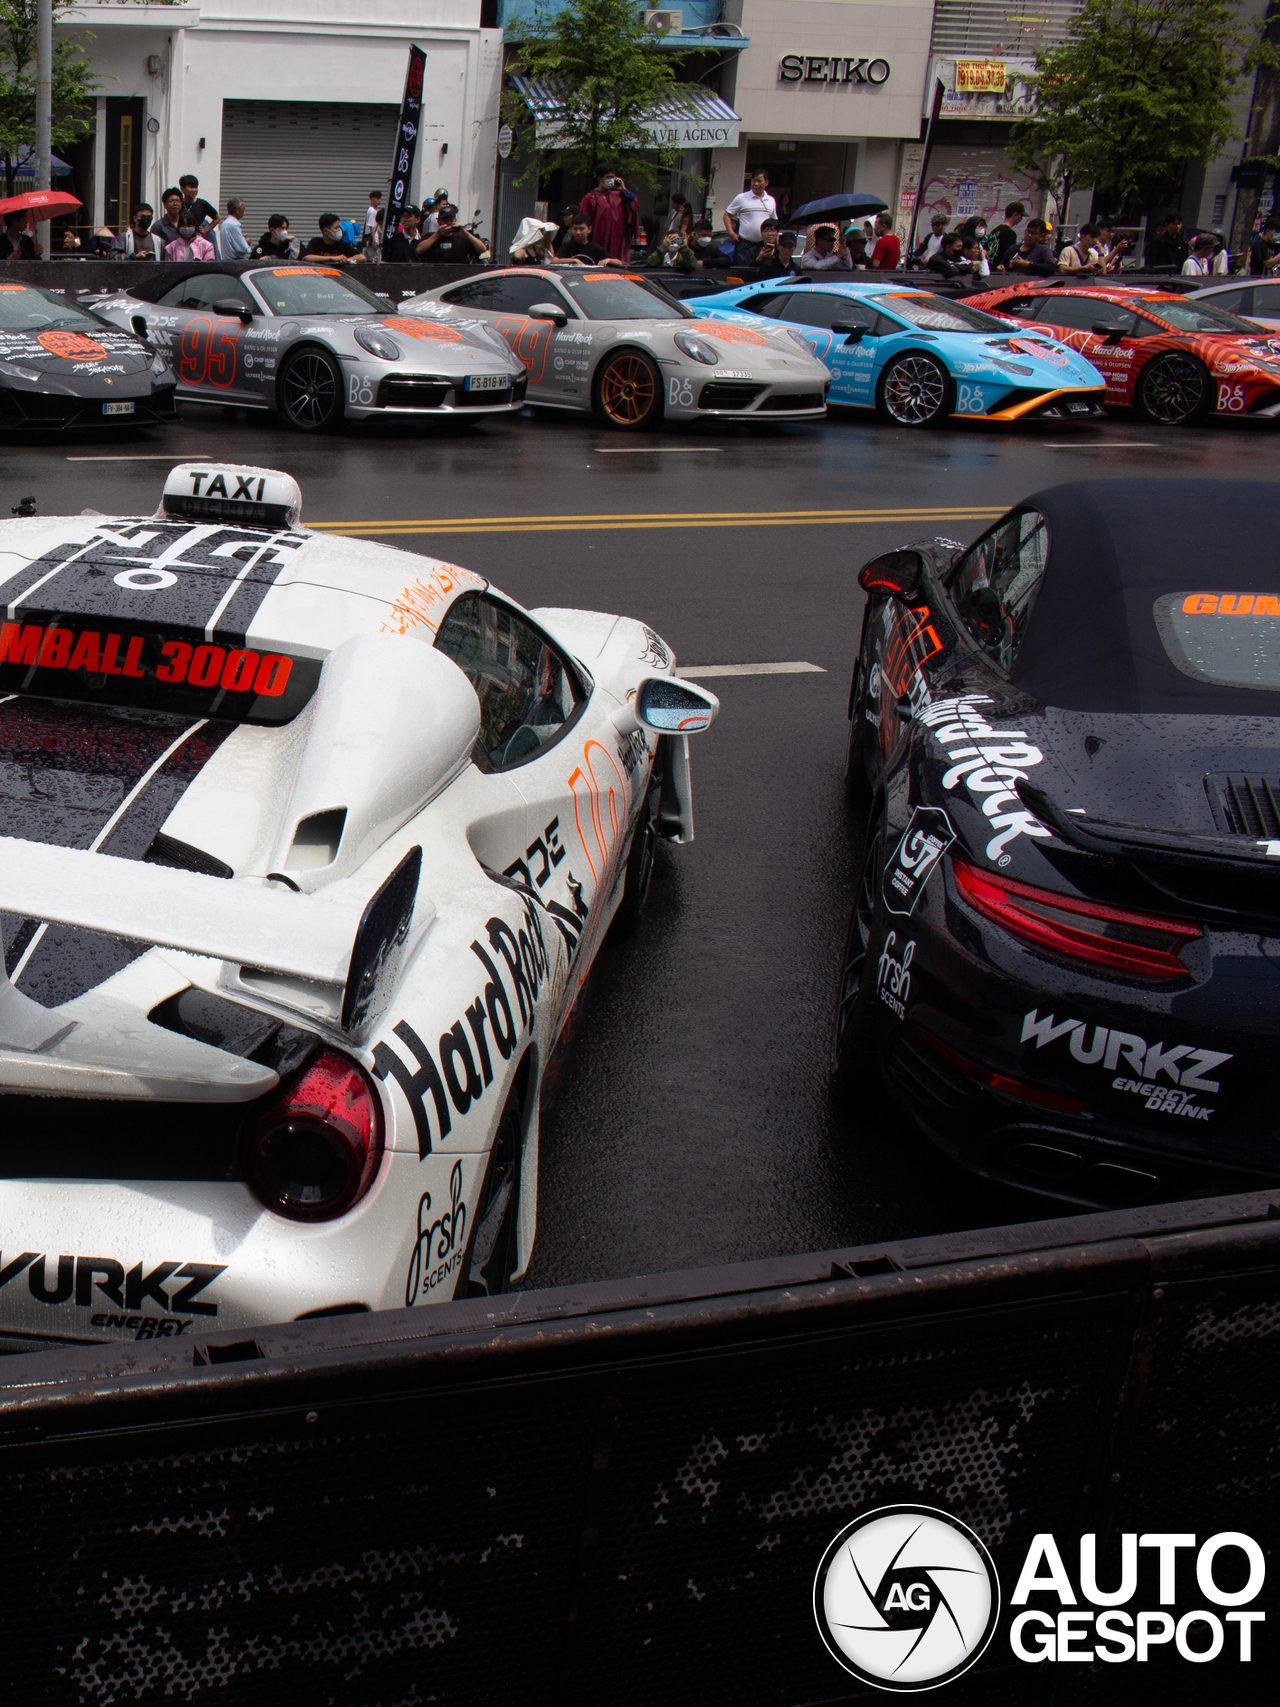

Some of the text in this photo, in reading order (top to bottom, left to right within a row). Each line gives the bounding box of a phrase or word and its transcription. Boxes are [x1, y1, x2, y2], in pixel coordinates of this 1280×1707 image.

[779, 54, 891, 84] SEIKO
[683, 129, 730, 141] AGENCY
[245, 327, 281, 342] Hard Rock
[555, 331, 593, 345] Hard Rock
[180, 317, 244, 387] 95
[834, 343, 876, 359] Hard Rock
[852, 360, 873, 368] OLUFSEN
[1092, 345, 1134, 359] Hard Rock
[471, 374, 507, 389] FS-816-WR
[842, 370, 854, 378] CHIP
[190, 472, 266, 502] TAXI
[155, 639, 294, 697] 3000
[941, 730, 1053, 864] Rock
[927, 834, 944, 848] COFFEE
[890, 877, 909, 897] COFFEE
[894, 867, 915, 889] INSTANT
[877, 930, 917, 1002] frsh
[879, 986, 906, 1021] SCENTS
[371, 940, 518, 1163] Hard
[1020, 1007, 1235, 1093] WURKZ
[1112, 1077, 1198, 1107] ENERGY
[1144, 1094, 1215, 1122] DRINK
[405, 1159, 467, 1308] frsh
[422, 1251, 465, 1295] SCENTS
[90, 1313, 194, 1334] ENERGY
